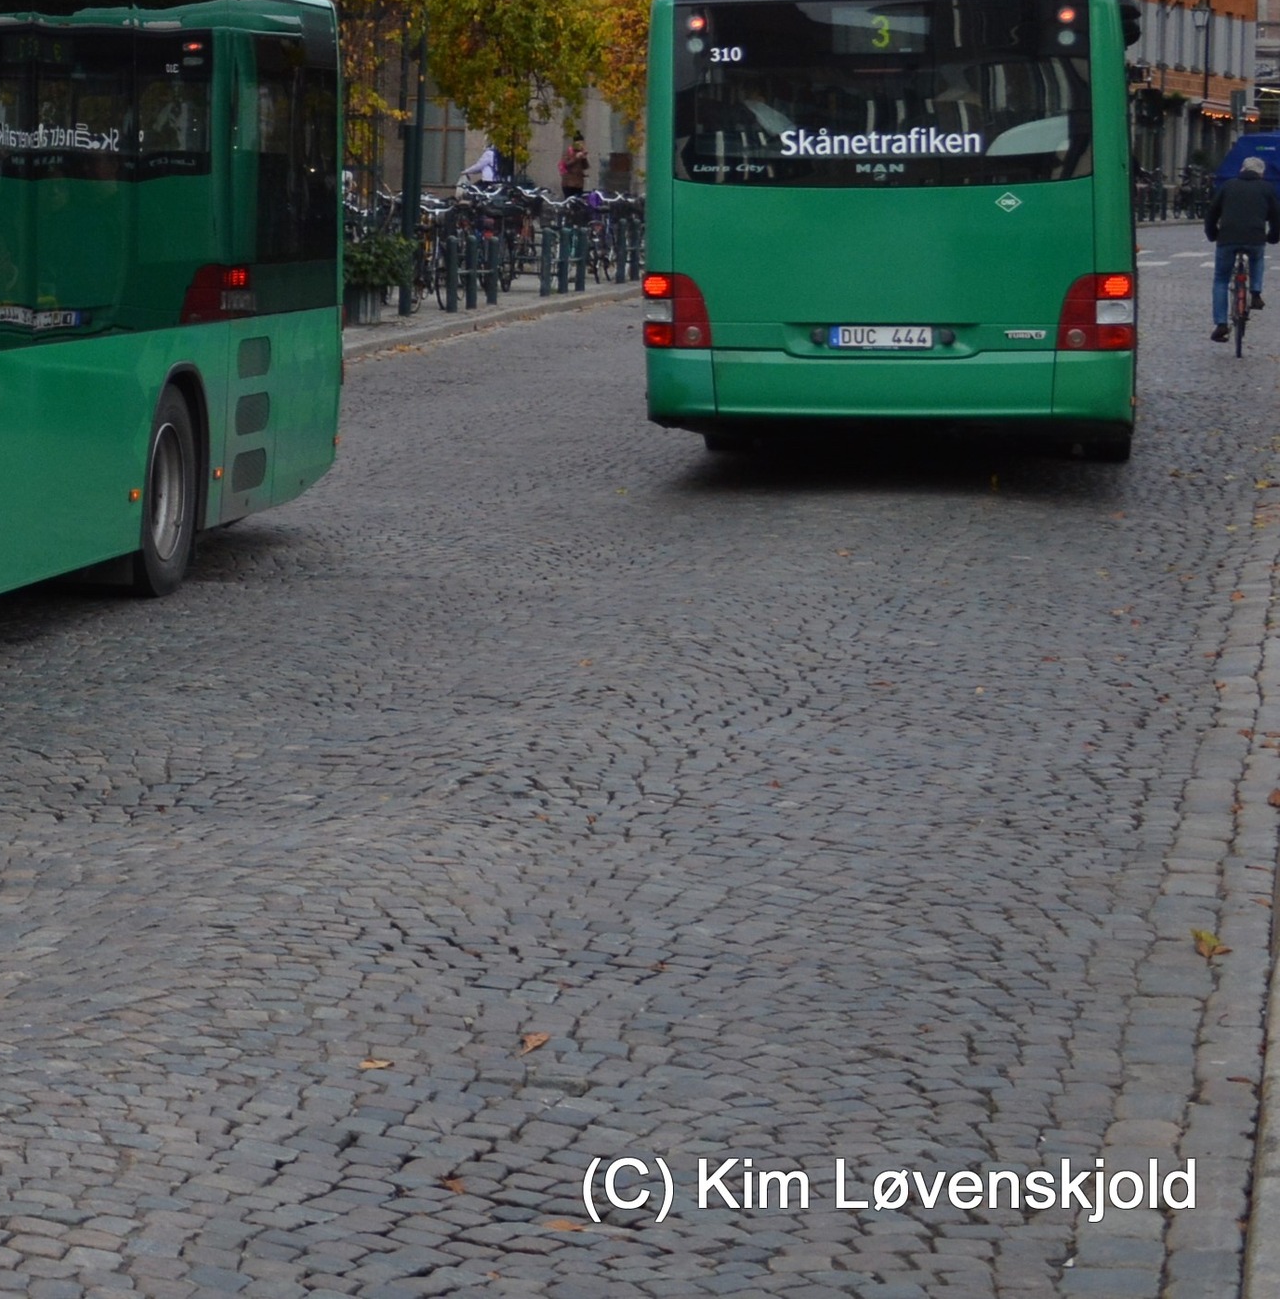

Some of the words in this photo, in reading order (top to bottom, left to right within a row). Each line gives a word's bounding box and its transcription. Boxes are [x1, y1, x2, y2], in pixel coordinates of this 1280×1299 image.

[870, 15, 891, 49] 3
[709, 47, 743, 62] 310
[779, 127, 982, 157] Skånetrafiken
[735, 163, 765, 174] City
[856, 163, 905, 174] MAN
[841, 328, 877, 344] DUC
[891, 328, 928, 344] 444
